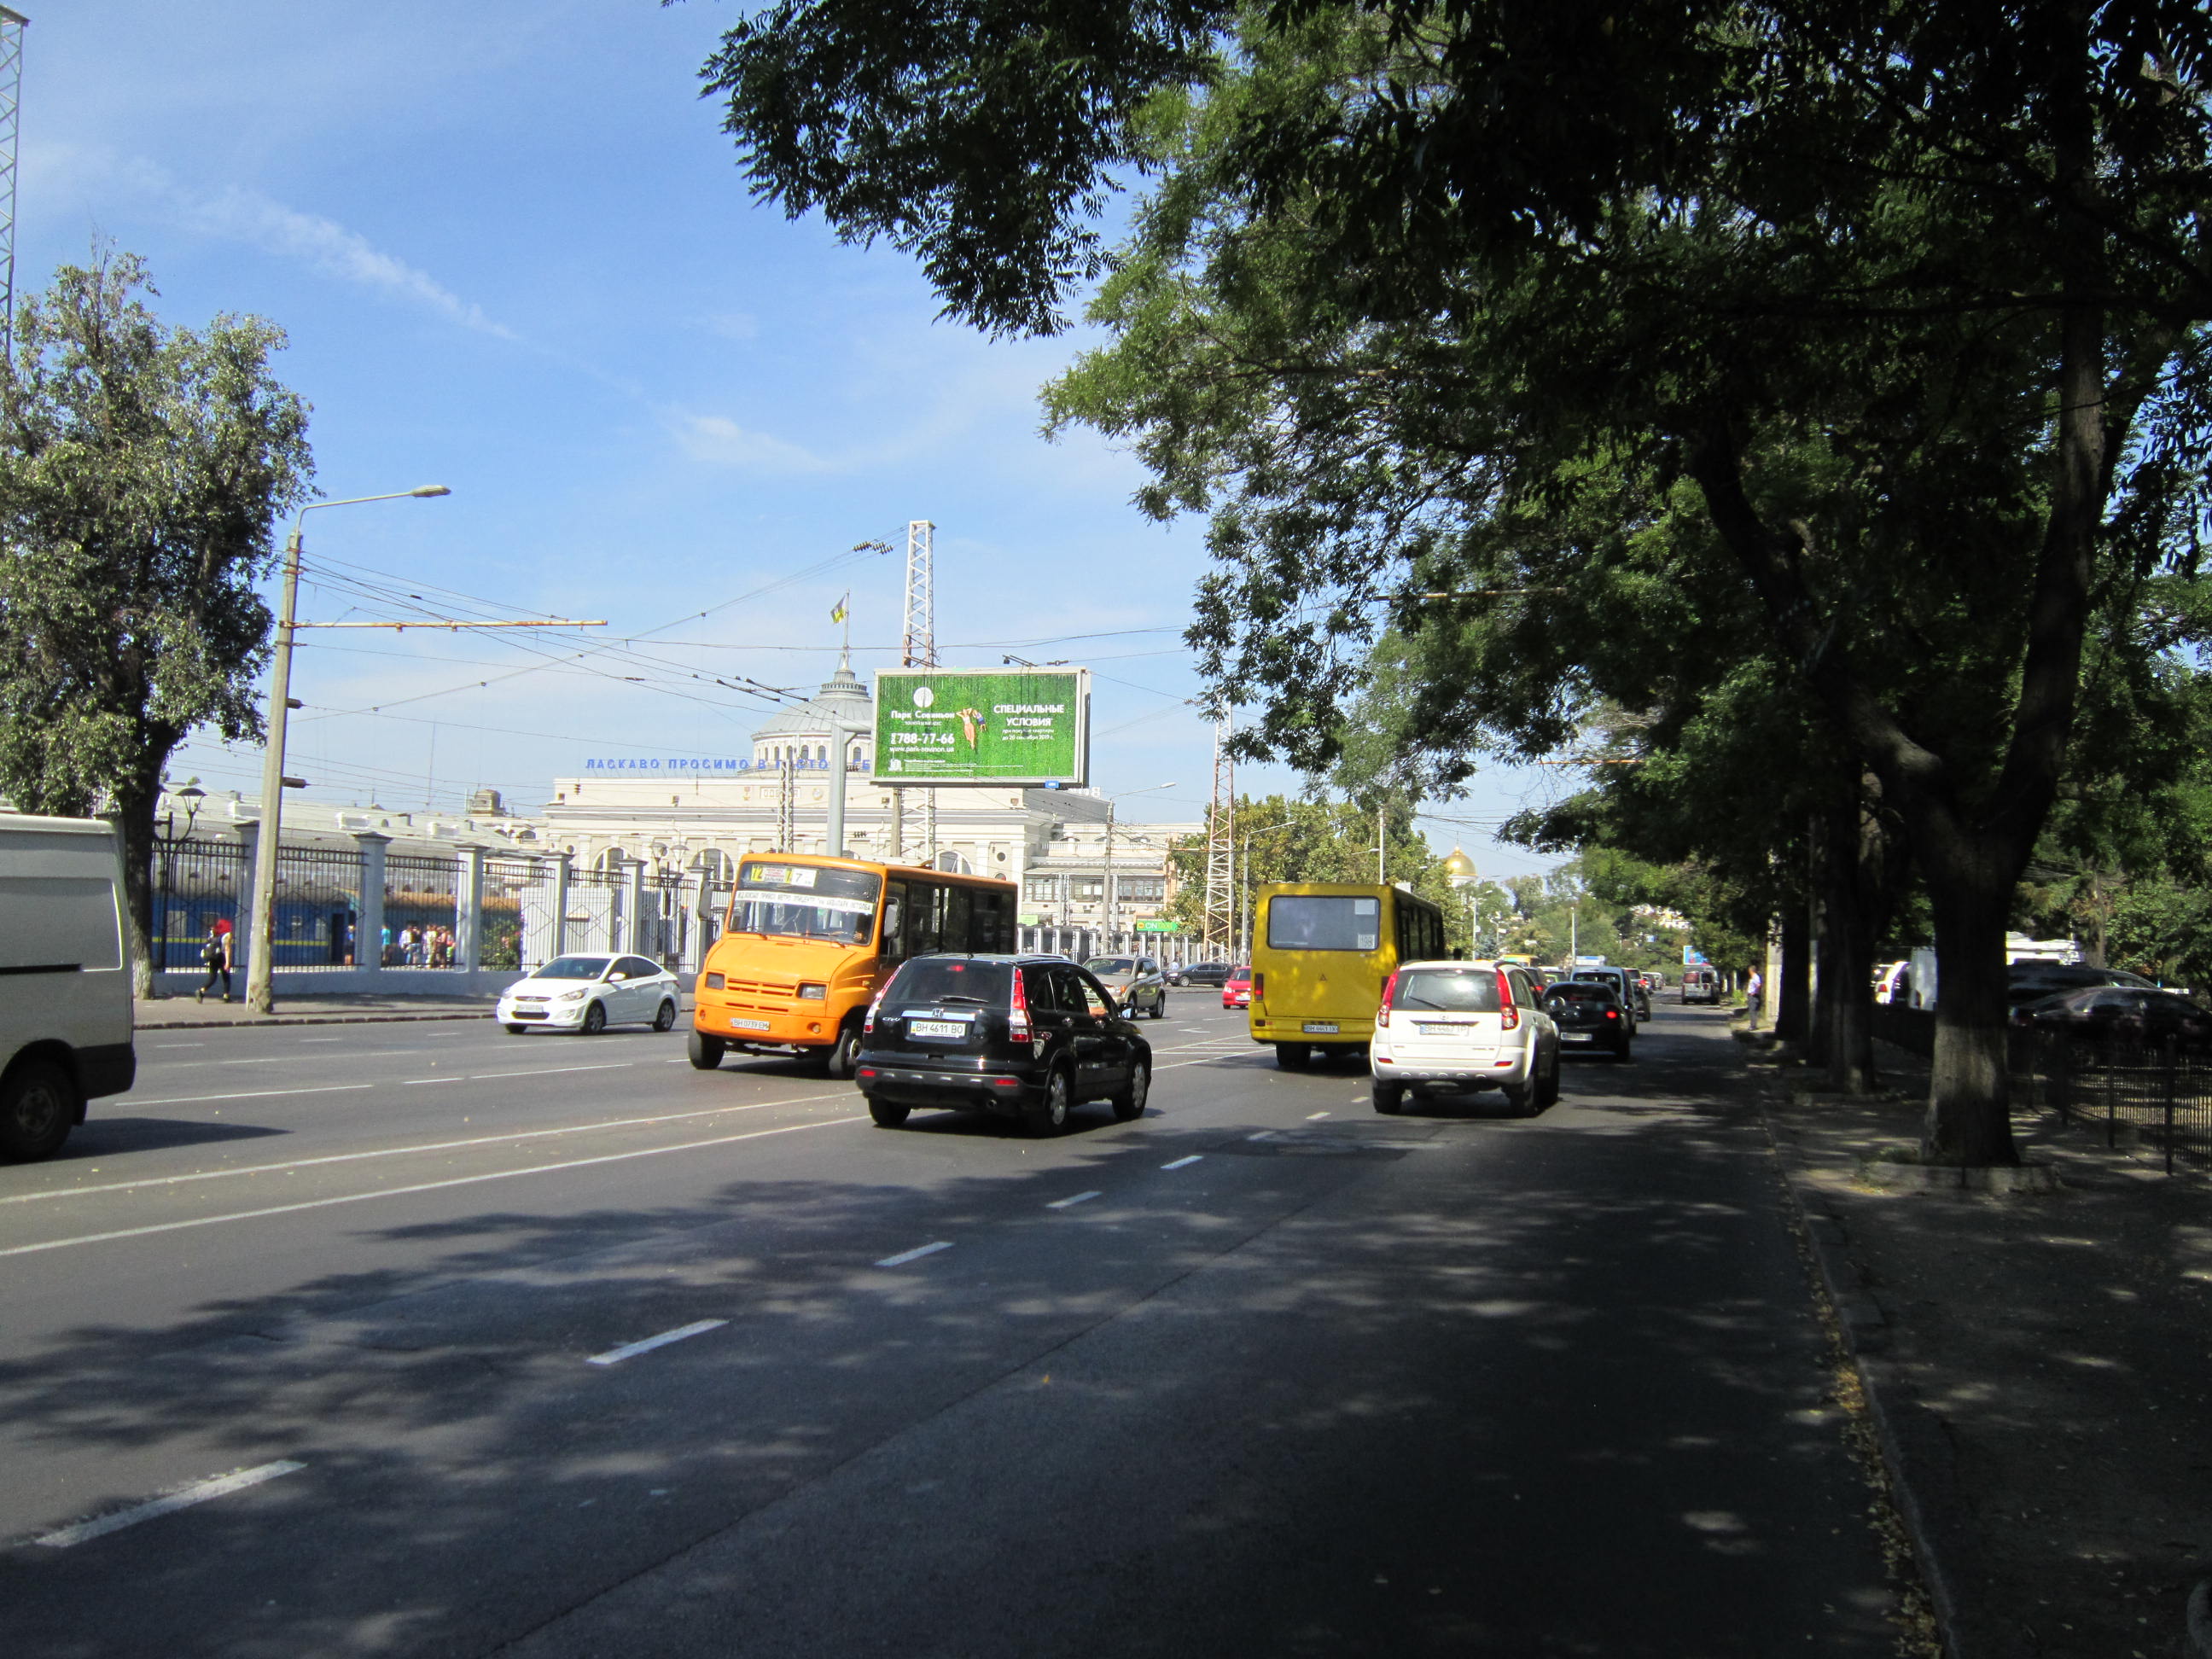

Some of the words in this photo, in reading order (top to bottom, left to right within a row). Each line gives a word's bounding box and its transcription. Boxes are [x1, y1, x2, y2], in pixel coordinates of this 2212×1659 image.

[993, 704, 1064, 714] СПЕЦИАЛЬНЫЕ
[891, 710, 911, 720] Парк
[914, 710, 955, 719] Совиньон
[897, 733, 955, 744] 788-77-66
[586, 759, 661, 769] ЛАСКАВО
[668, 759, 749, 769] ПРОСИМО
[758, 759, 766, 769] В
[916, 1022, 928, 1033] BH
[929, 1023, 948, 1033] 4611
[951, 1024, 963, 1034] BO
